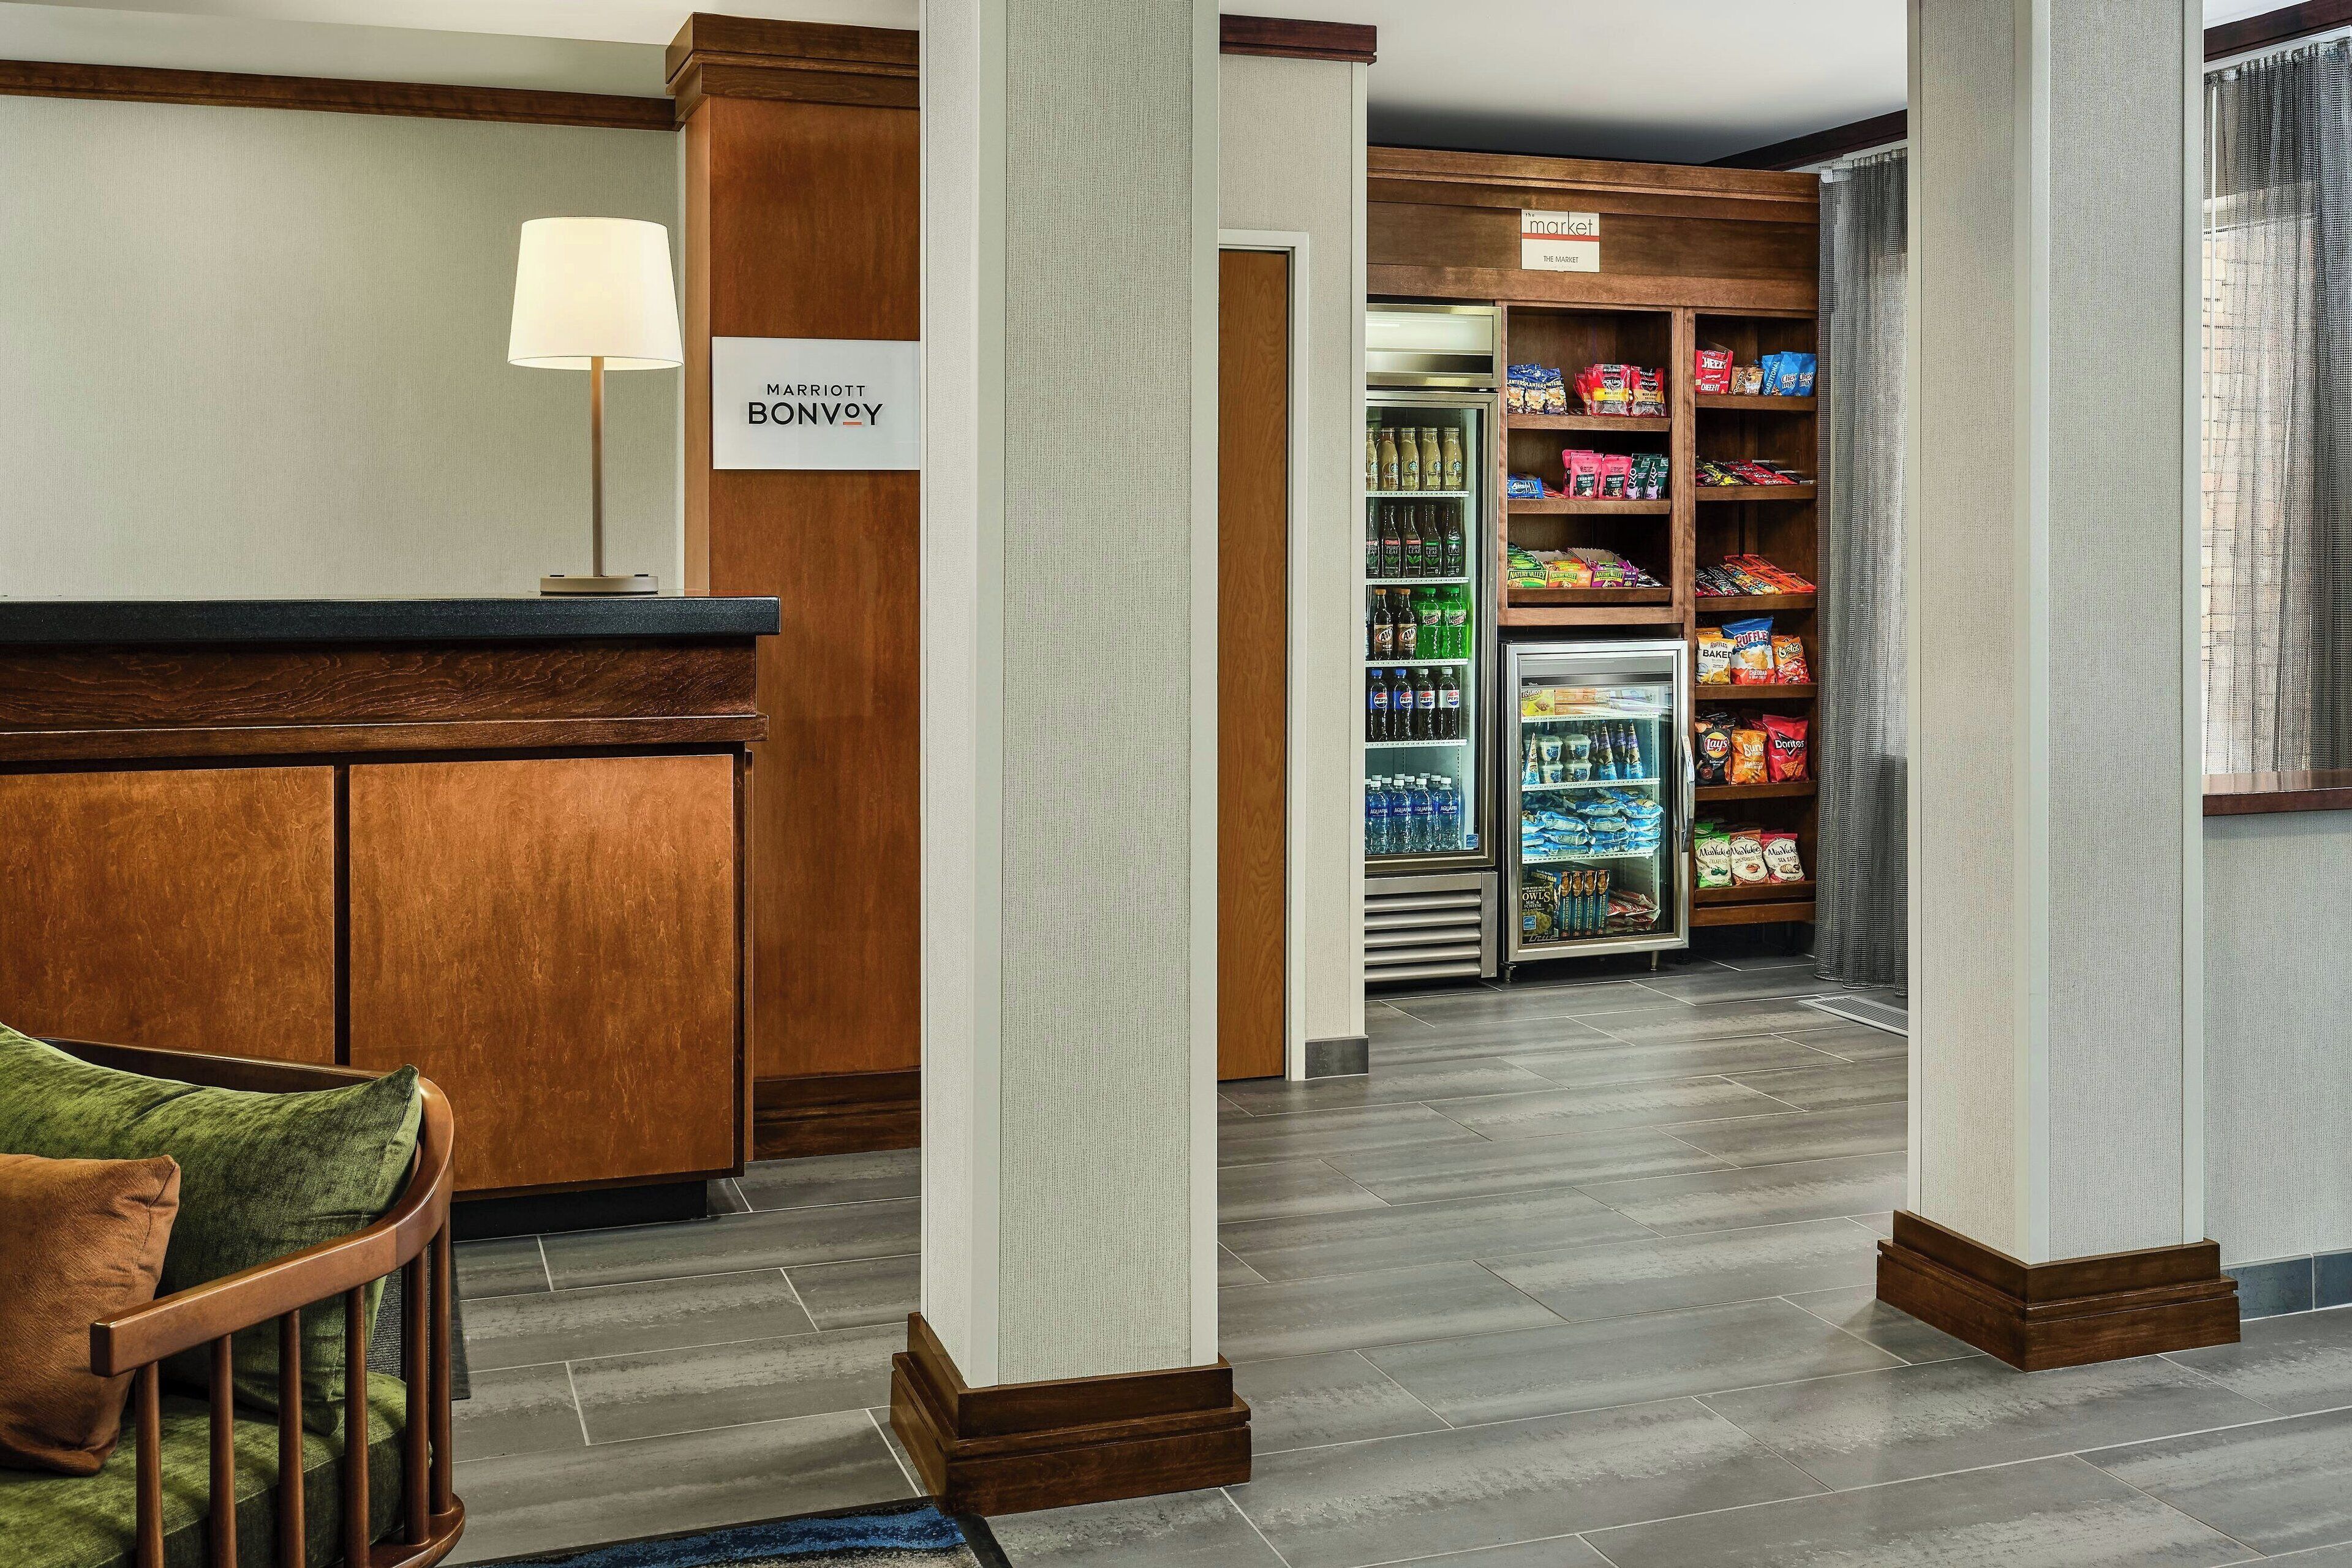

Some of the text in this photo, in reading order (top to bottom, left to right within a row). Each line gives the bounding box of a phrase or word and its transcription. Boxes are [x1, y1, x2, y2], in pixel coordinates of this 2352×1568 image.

[1530, 211, 1593, 236] market
[1781, 372, 1798, 383] Chex
[1782, 380, 1795, 389] mix
[766, 383, 865, 397] MARRIOTT
[748, 401, 883, 426] BONVOY
[1529, 571, 1546, 579] VALLEY
[1774, 739, 1804, 748] Doritos
[1699, 848, 1714, 857] Miss
[1730, 846, 1744, 856] Miss
[1521, 891, 1551, 902] OWLS
